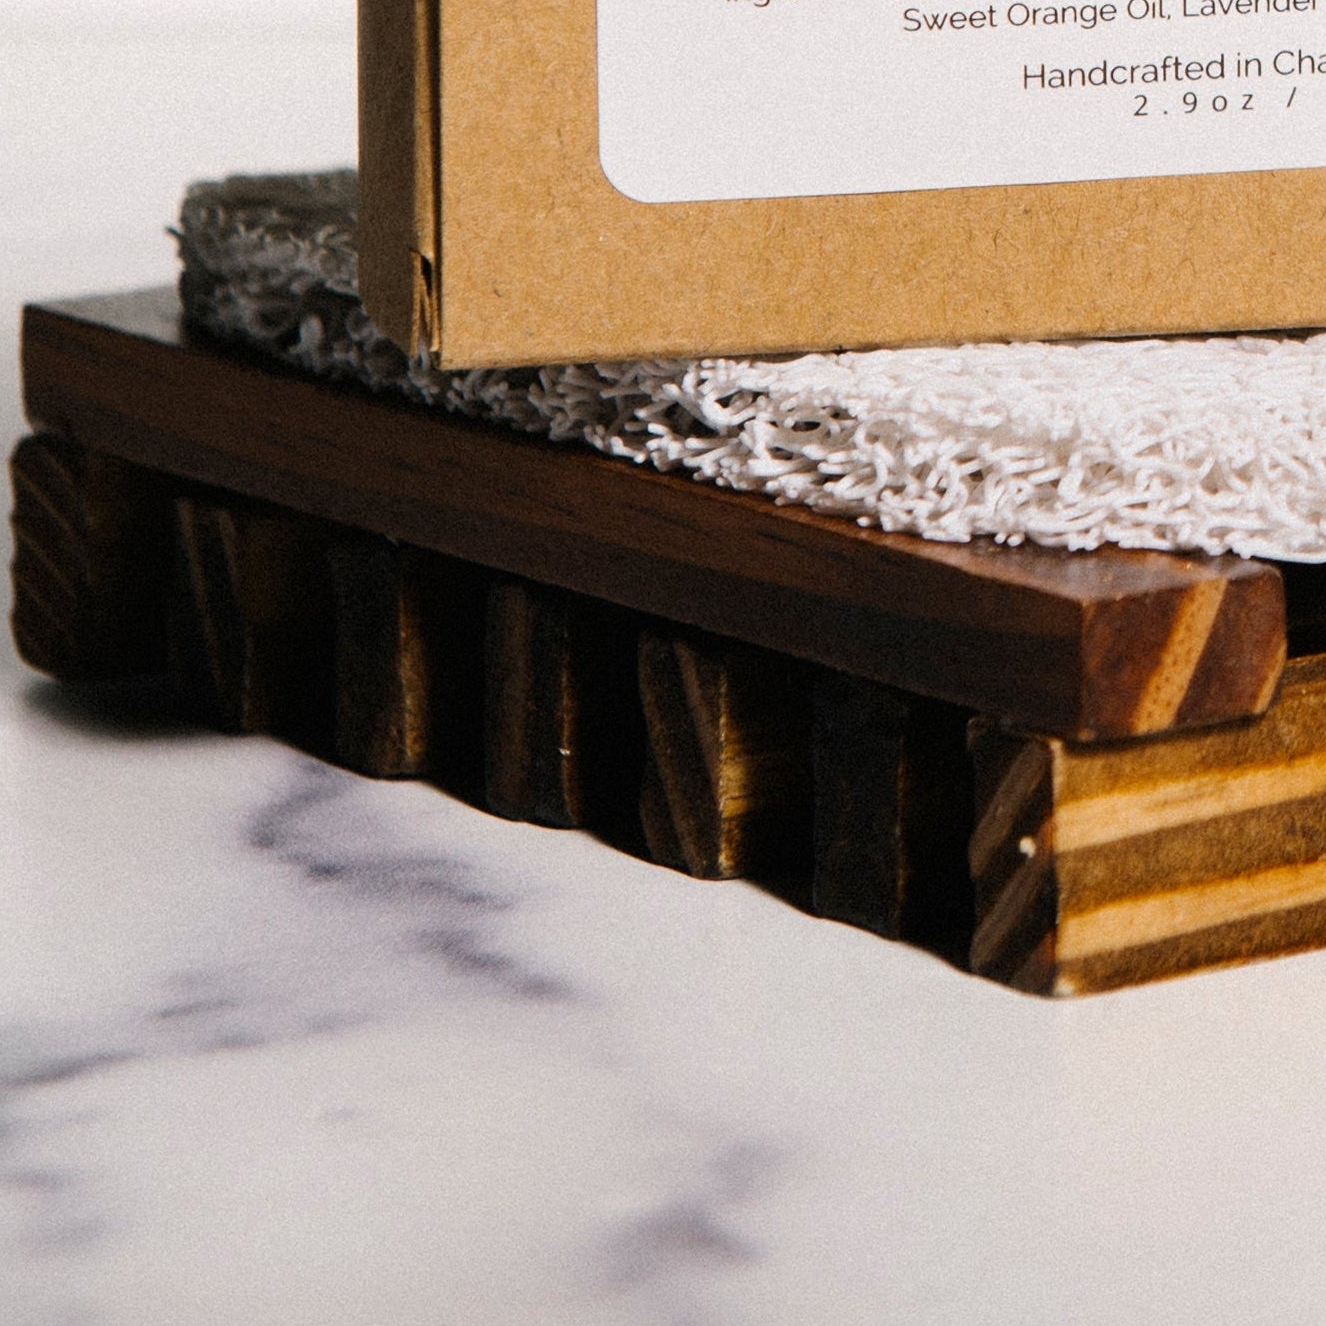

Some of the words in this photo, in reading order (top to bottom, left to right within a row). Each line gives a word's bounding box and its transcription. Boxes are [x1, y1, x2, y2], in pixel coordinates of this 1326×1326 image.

[903, 5, 997, 32] Sweet
[1007, 2, 1117, 30] Orange
[1023, 53, 1225, 89] Handcrafted
[1237, 57, 1262, 78] in
[1133, 91, 1253, 117] 2.9oz
